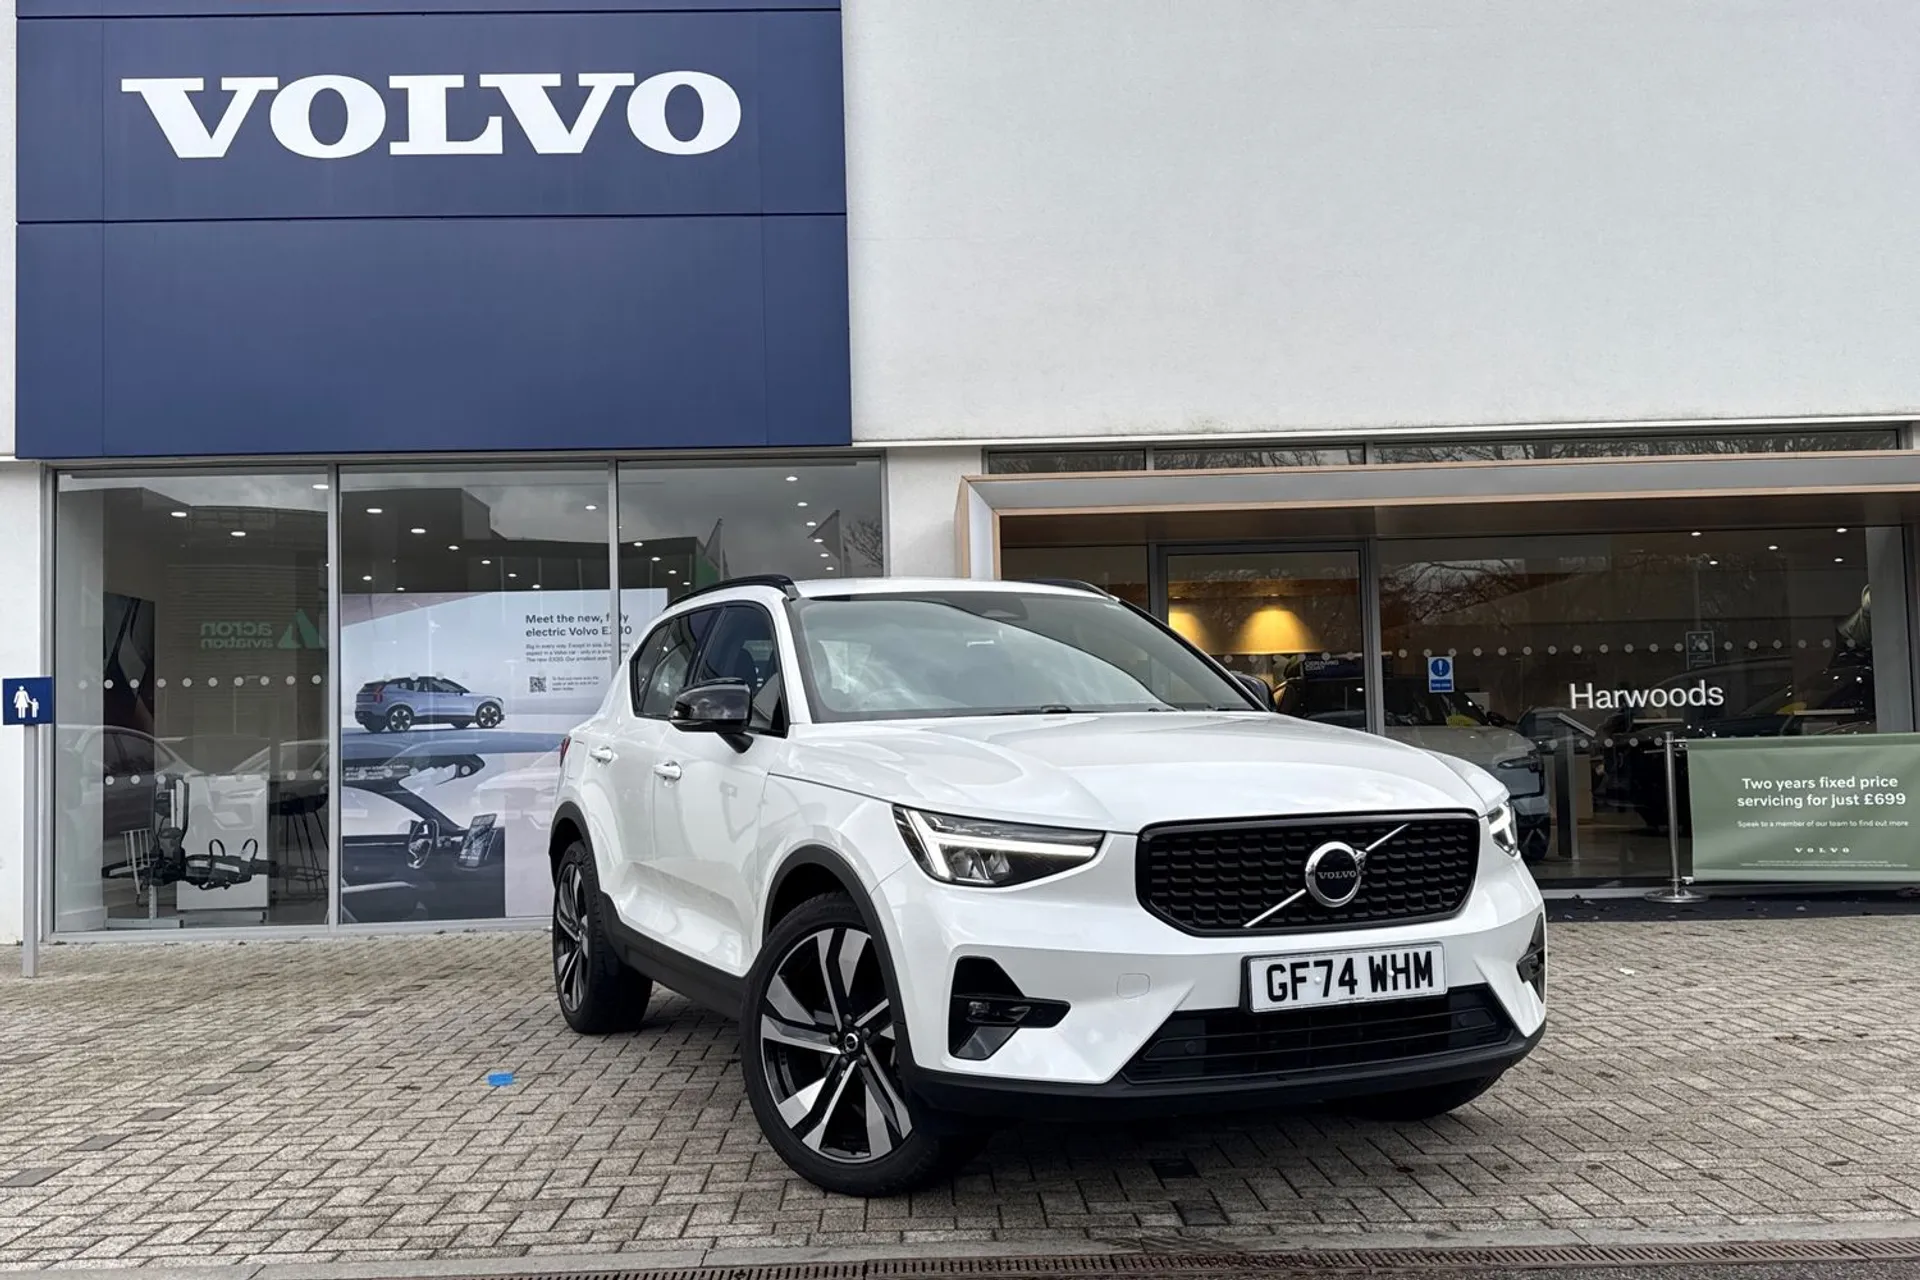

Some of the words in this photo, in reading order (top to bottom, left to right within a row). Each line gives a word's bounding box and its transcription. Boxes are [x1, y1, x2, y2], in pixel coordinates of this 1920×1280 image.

[121, 71, 742, 159] VOLVO
[525, 614, 554, 624] Meet
[556, 614, 575, 623] the
[577, 615, 603, 624] new,
[526, 627, 566, 638] electric
[569, 626, 598, 636] Volvo
[1570, 679, 1725, 710] Harwoods
[1741, 778, 1772, 790] Two
[1776, 779, 1816, 792] years
[1820, 776, 1856, 788] fixed
[1860, 775, 1898, 790] price
[1737, 794, 1803, 808] servicing
[1806, 794, 1828, 806] for
[1830, 793, 1860, 808] just
[1864, 792, 1906, 806] £699
[1317, 870, 1357, 880] VOLVO
[1266, 957, 1358, 1002] GF74
[1369, 950, 1434, 993] WHM
